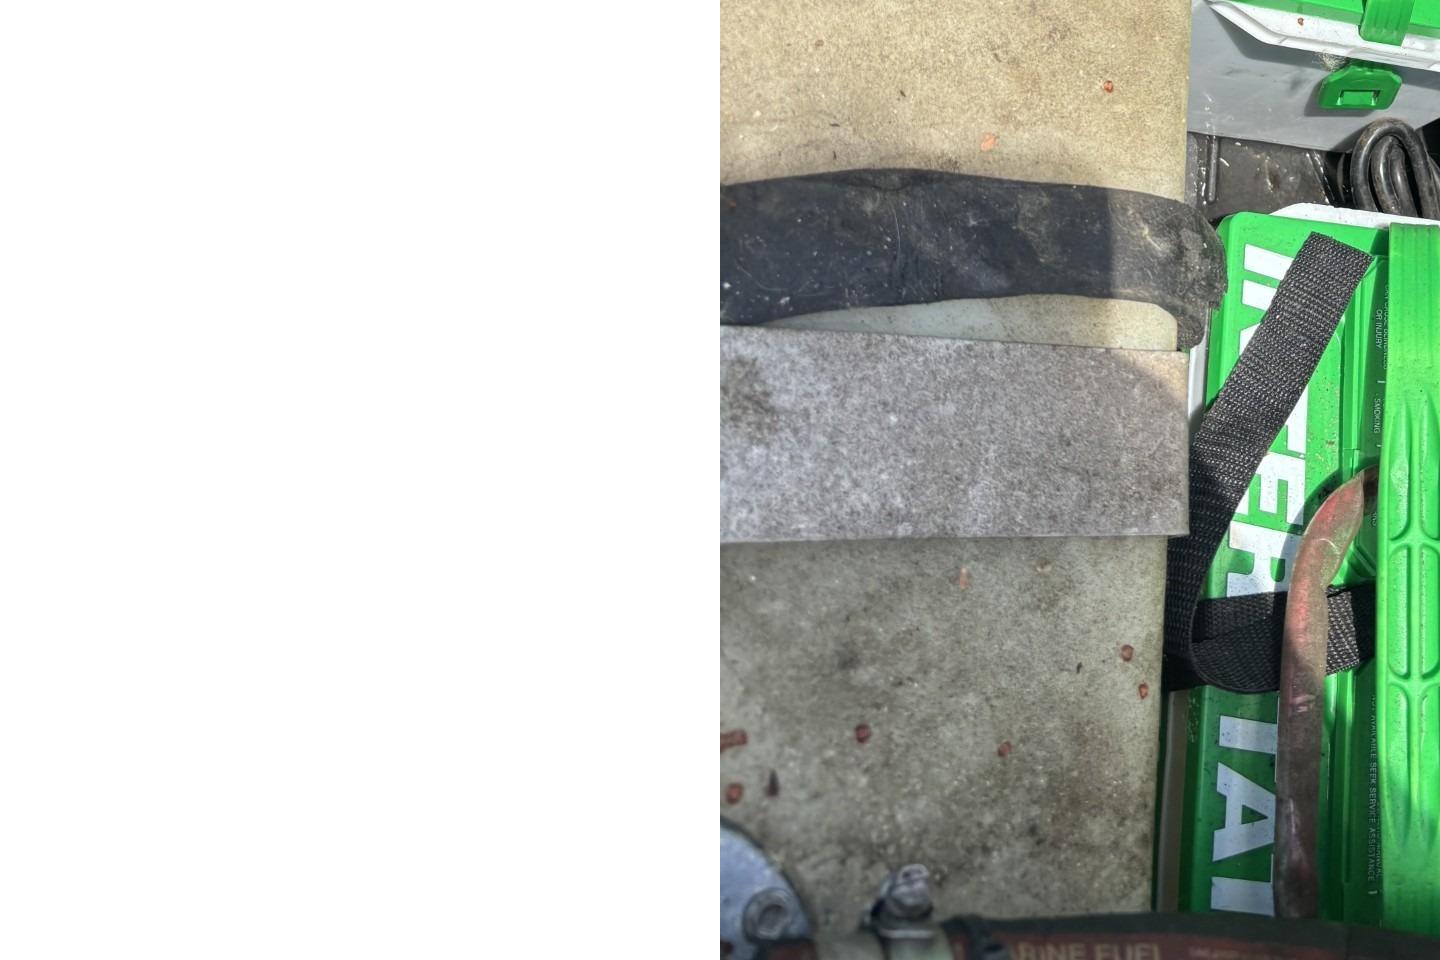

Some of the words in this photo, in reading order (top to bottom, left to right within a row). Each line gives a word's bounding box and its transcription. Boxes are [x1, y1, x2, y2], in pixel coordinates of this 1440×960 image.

[1376, 310, 1383, 321] OR
[1373, 398, 1381, 434] SMOKING
[1369, 762, 1377, 785] SEEK
[1369, 787, 1377, 823] SERVICE
[1368, 827, 1377, 881] ASSISTANCE
